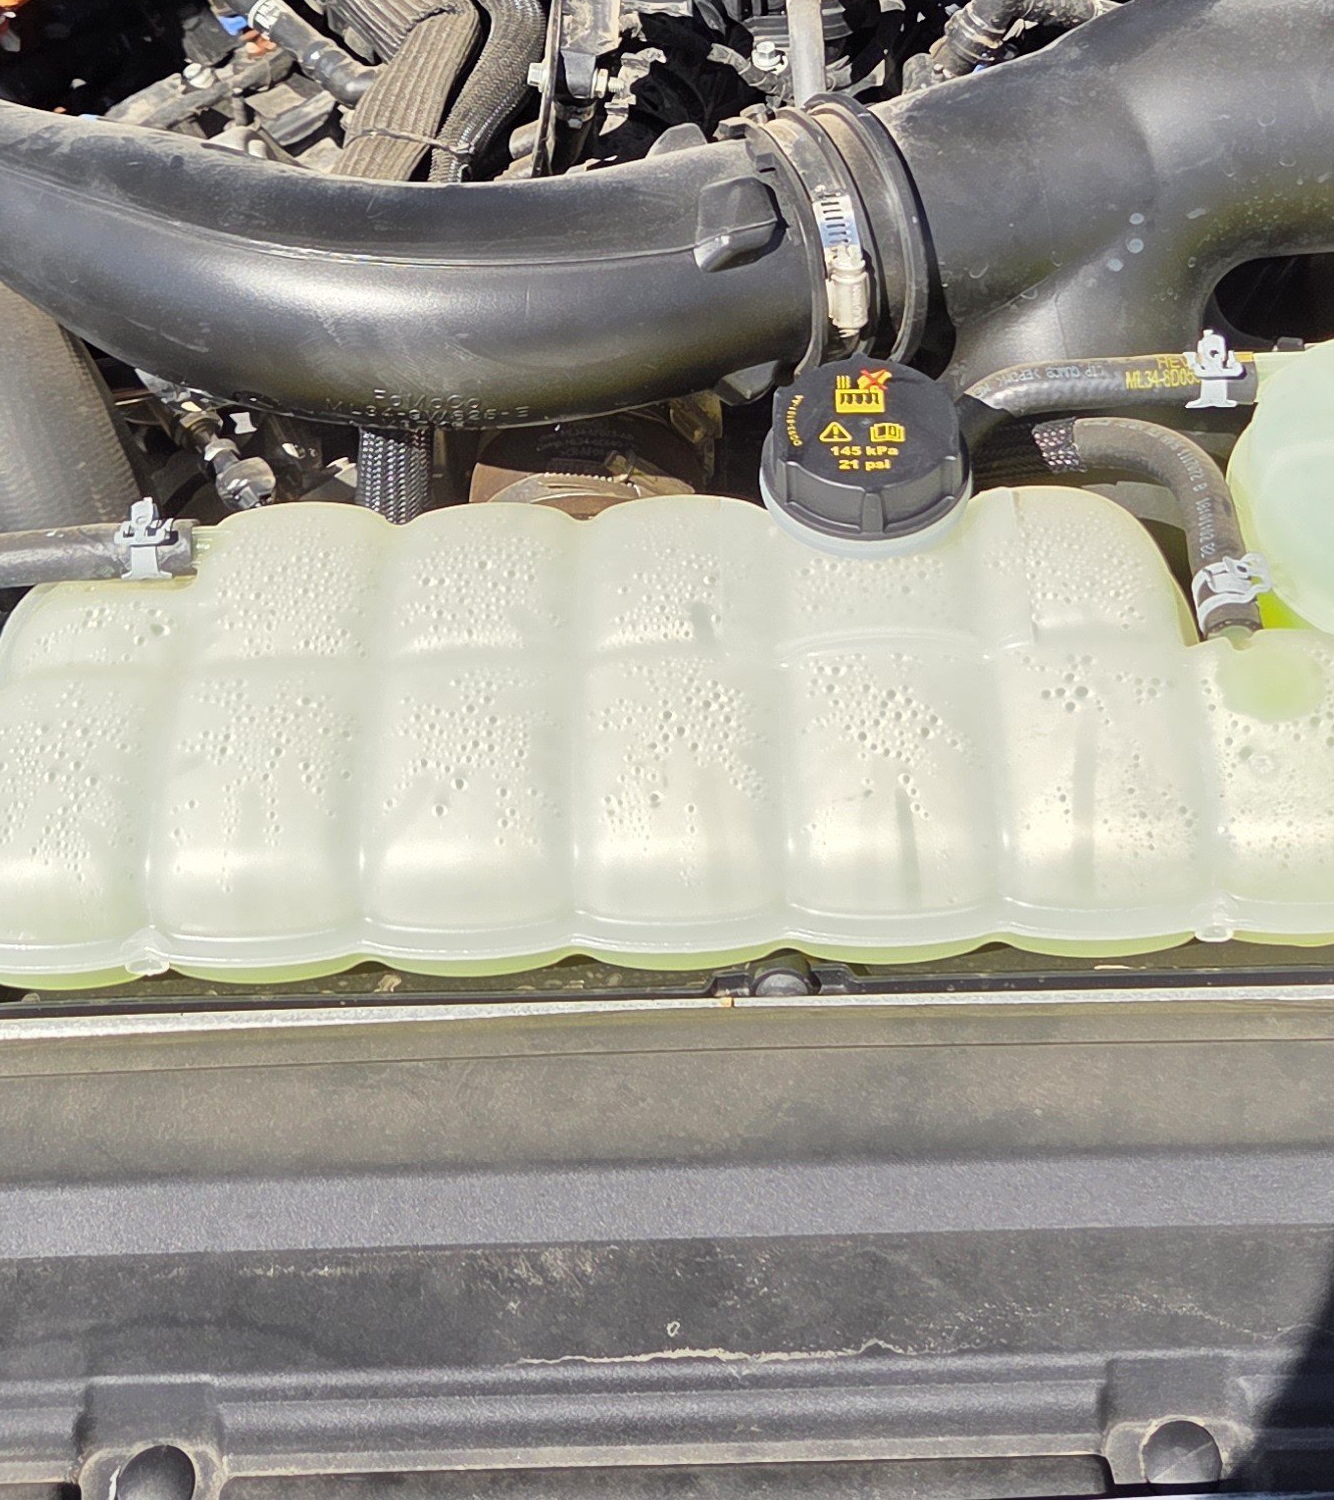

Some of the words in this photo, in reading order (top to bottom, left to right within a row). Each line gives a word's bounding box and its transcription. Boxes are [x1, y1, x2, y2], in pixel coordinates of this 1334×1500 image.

[830, 445, 862, 456] 145
[866, 445, 899, 456] kPa
[838, 459, 861, 470] 21
[865, 459, 891, 471] psi
